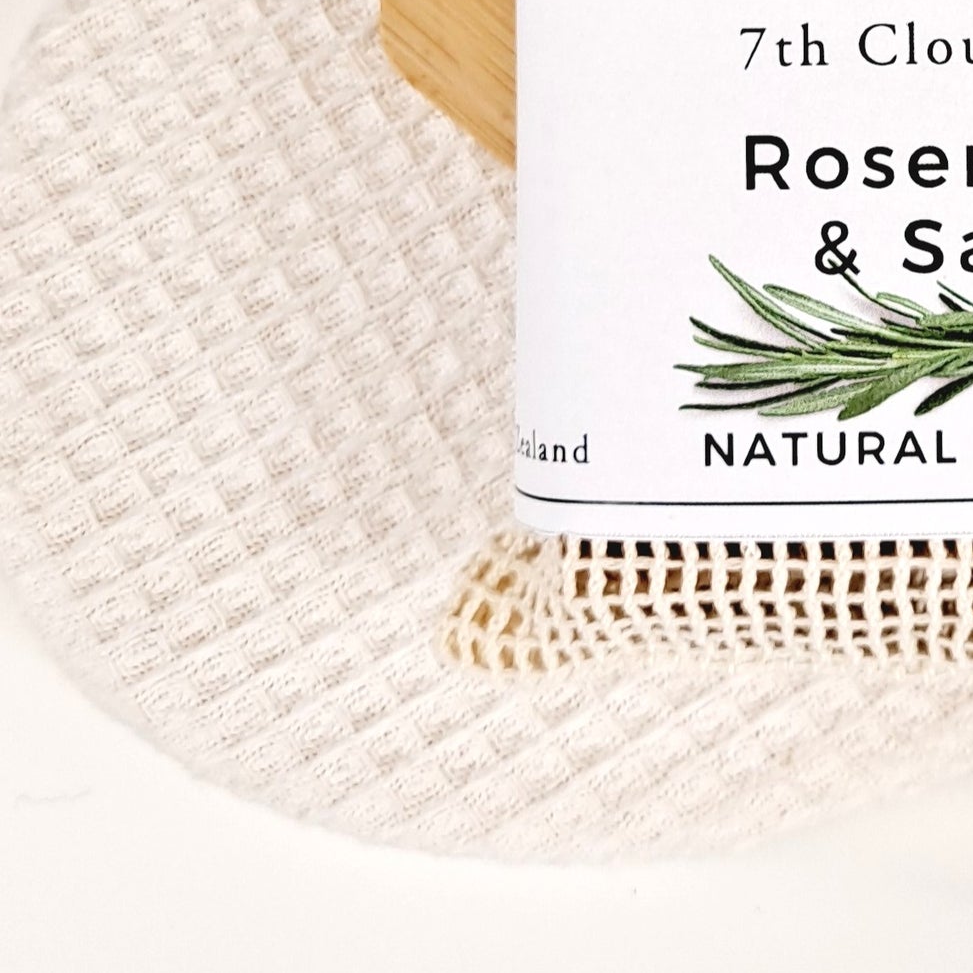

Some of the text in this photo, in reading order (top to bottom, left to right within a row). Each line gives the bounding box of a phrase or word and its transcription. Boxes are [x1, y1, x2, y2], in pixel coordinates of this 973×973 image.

[739, 23, 829, 71] 7th
[813, 221, 860, 276] &
[704, 428, 957, 467] NATURAL
